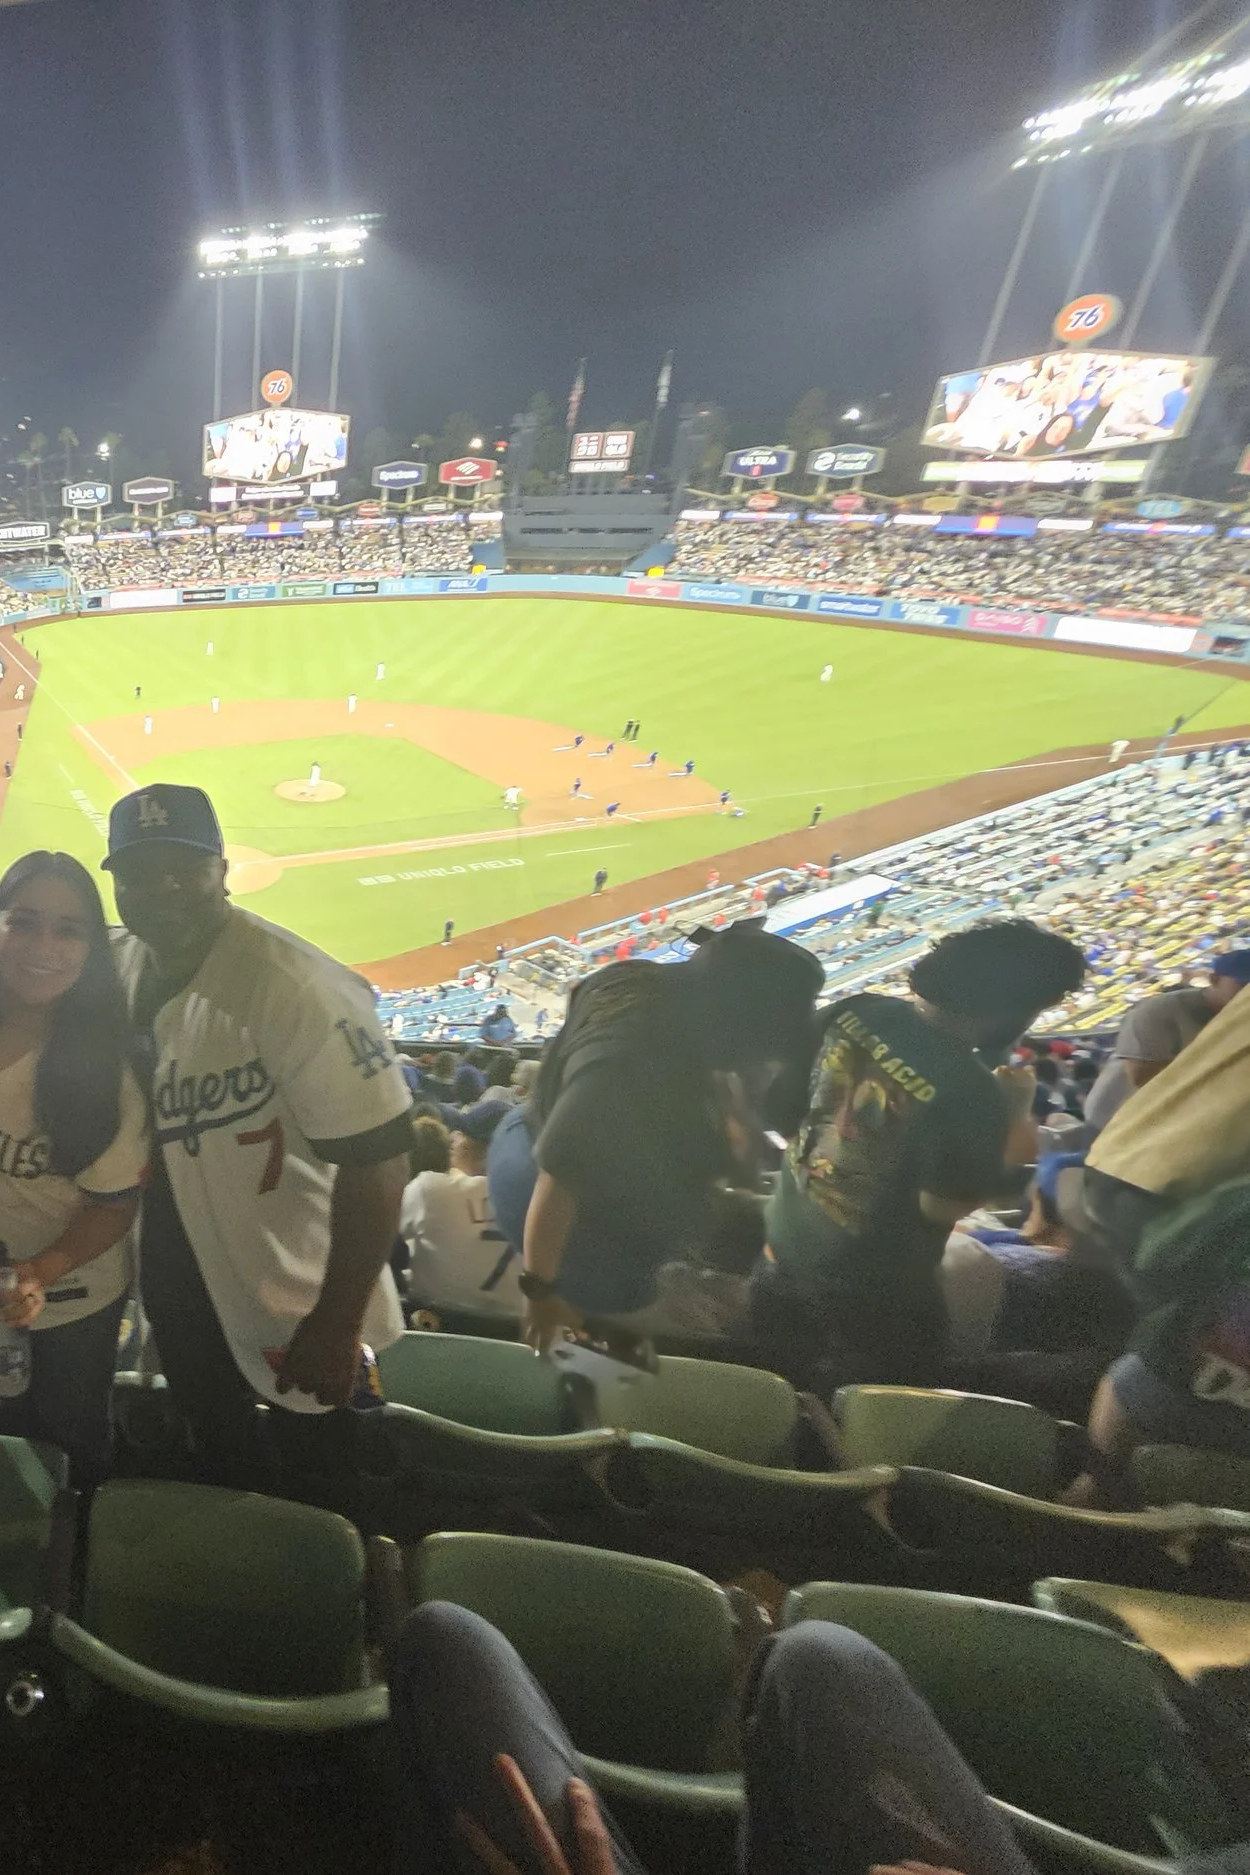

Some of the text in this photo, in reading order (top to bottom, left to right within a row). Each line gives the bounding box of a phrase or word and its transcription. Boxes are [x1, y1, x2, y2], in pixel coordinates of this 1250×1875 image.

[1069, 305, 1102, 329] 76
[269, 379, 286, 394] 76
[68, 488, 95, 499] blue
[138, 795, 168, 827] LA
[398, 858, 525, 880] UNIQLO FIELD
[335, 1018, 391, 1080] LA
[157, 1057, 270, 1157] dgers
[237, 1116, 284, 1195] 7
